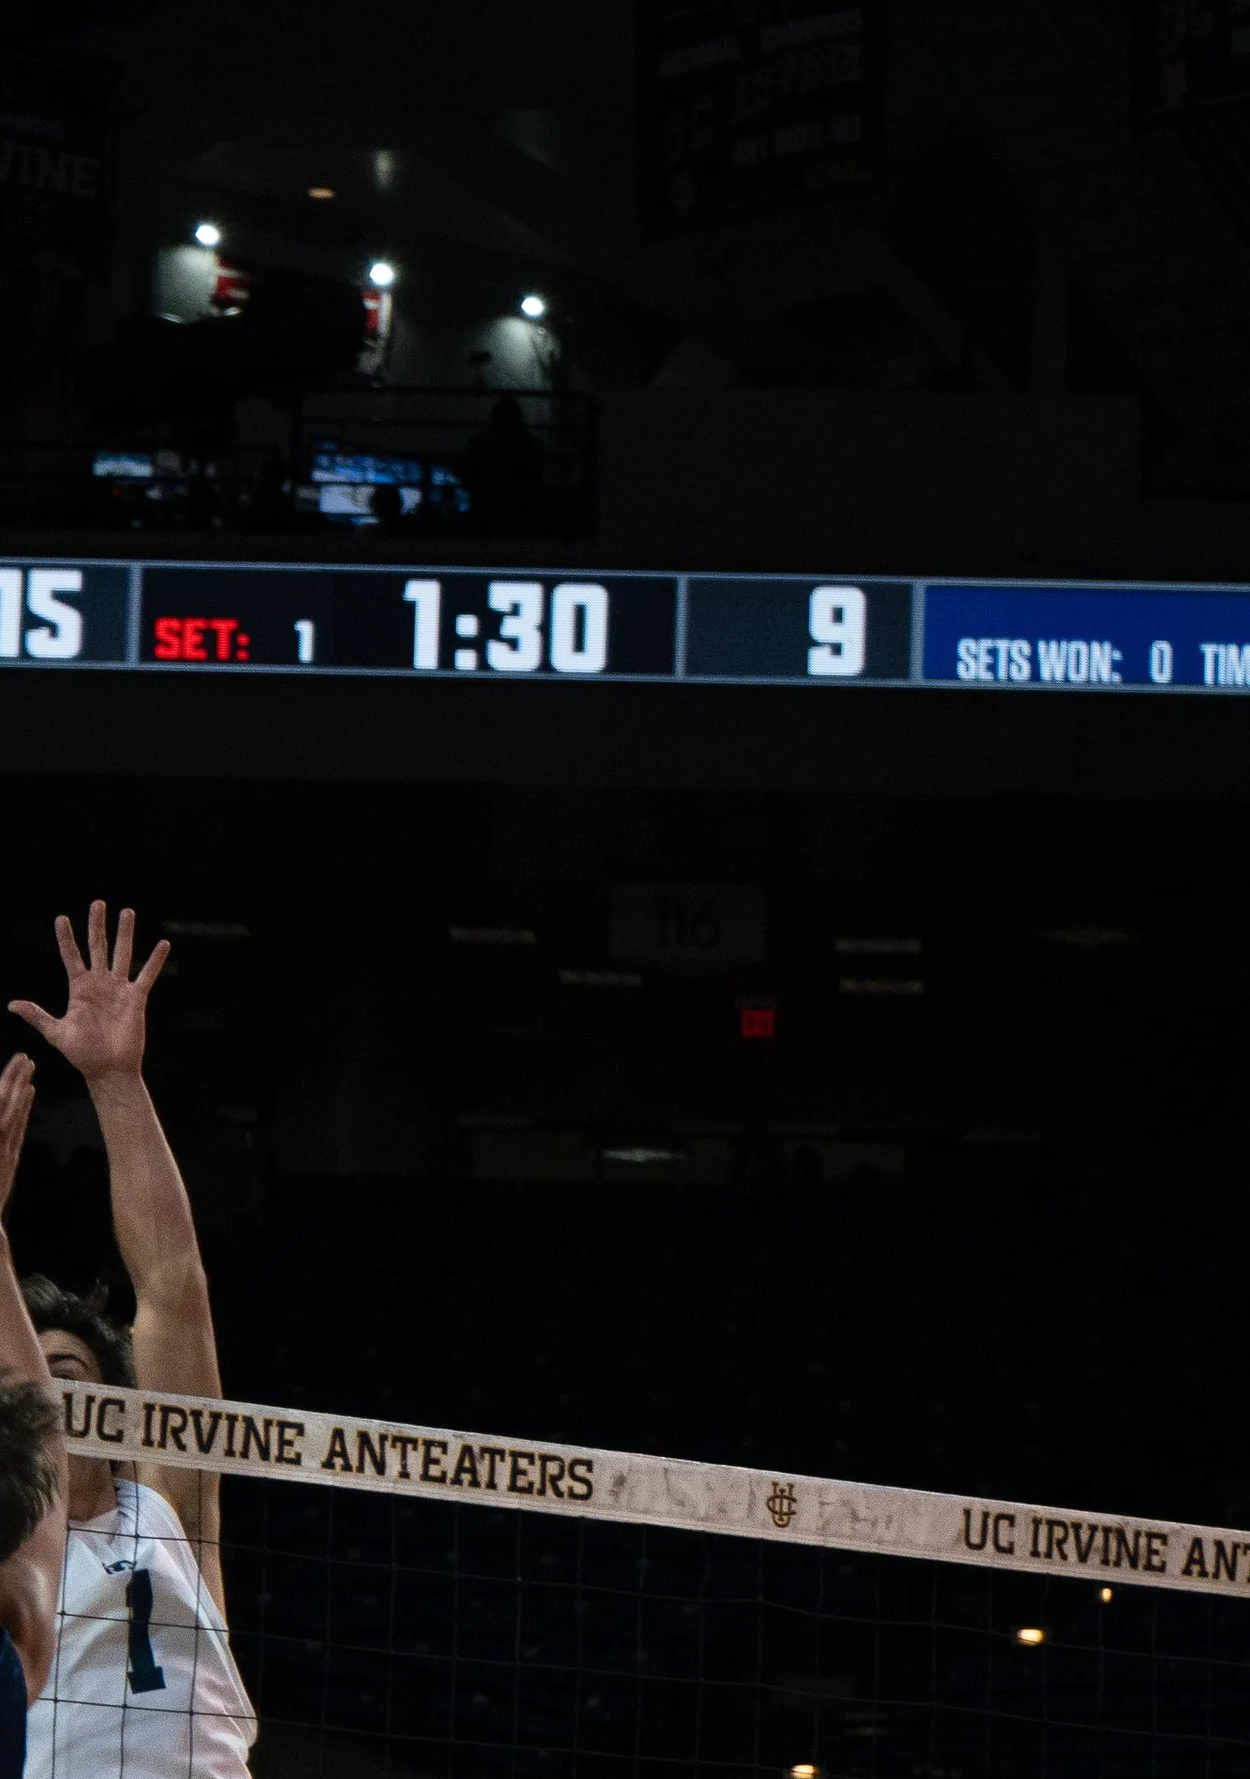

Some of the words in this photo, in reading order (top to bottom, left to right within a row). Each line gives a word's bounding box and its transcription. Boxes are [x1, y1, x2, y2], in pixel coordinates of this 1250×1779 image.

[153, 617, 250, 661] SET:
[293, 619, 315, 664] 1
[402, 578, 610, 674] 1:30
[806, 585, 867, 677] 9
[956, 637, 1032, 682] SETS
[1036, 639, 1124, 684] WON:
[1149, 640, 1174, 685] 0
[62, 1391, 127, 1444] UC
[141, 1402, 305, 1467] IRVINE
[320, 1426, 595, 1502] ANTEATERS
[962, 1507, 1016, 1556] UC
[1029, 1515, 1169, 1575] IRVINE
[125, 1567, 167, 1695] 1
